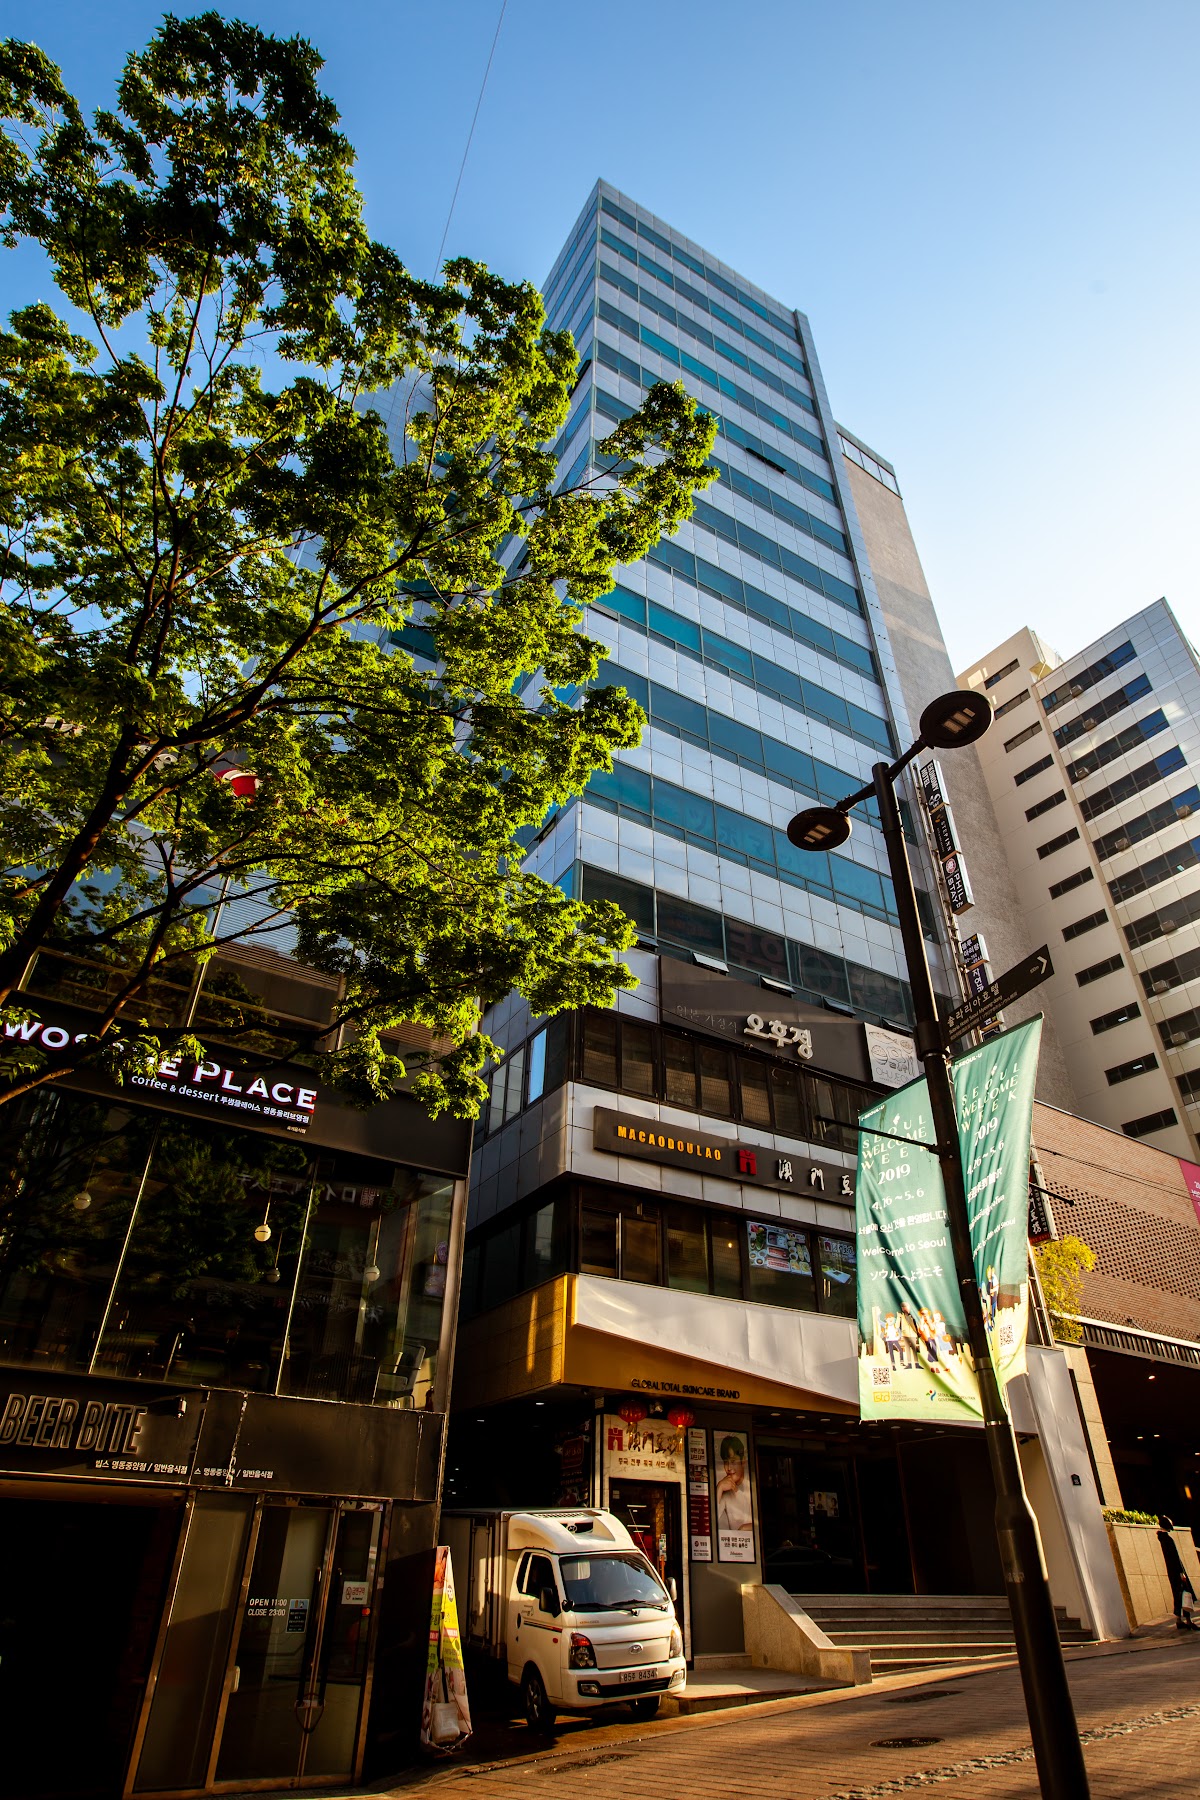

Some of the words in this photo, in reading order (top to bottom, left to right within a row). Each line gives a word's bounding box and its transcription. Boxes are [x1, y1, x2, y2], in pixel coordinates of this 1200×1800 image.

[921, 768, 931, 788] HOTEL
[948, 877, 958, 903] STAY
[954, 874, 964, 901] PHIL
[947, 982, 1000, 1028] 솔라리아호텔
[743, 1013, 814, 1060] 오후정
[178, 1084, 219, 1102] dessert
[193, 1060, 317, 1110] PLACE
[961, 1062, 1020, 1106] SEOUL
[962, 1074, 1018, 1119] WELCOME
[617, 1125, 721, 1161] MACAODOULAO
[862, 1114, 926, 1148] SEOUL
[862, 1126, 927, 1160] WELCOME
[878, 1163, 911, 1185] 2019
[907, 1210, 947, 1226] 환영합니다
[862, 1245, 904, 1257] Welcome
[905, 1242, 915, 1252] to
[918, 1237, 947, 1249] Seoul
[631, 1378, 660, 1391] GLOBAL
[661, 1381, 681, 1393] TOTAL
[682, 1385, 716, 1397] SKINCARE
[716, 1388, 740, 1399] BRAND
[0, 1393, 80, 1449] BEER
[75, 1400, 149, 1455] BITE
[111, 1460, 147, 1472] 명동중앙점
[153, 1463, 188, 1475] 일반음식점
[242, 1469, 274, 1479] 일반음식점
[247, 1608, 267, 1616] CLOSE
[248, 1598, 270, 1606] OPEN
[271, 1598, 288, 1606] 11:00
[638, 1670, 655, 1679] 8434
